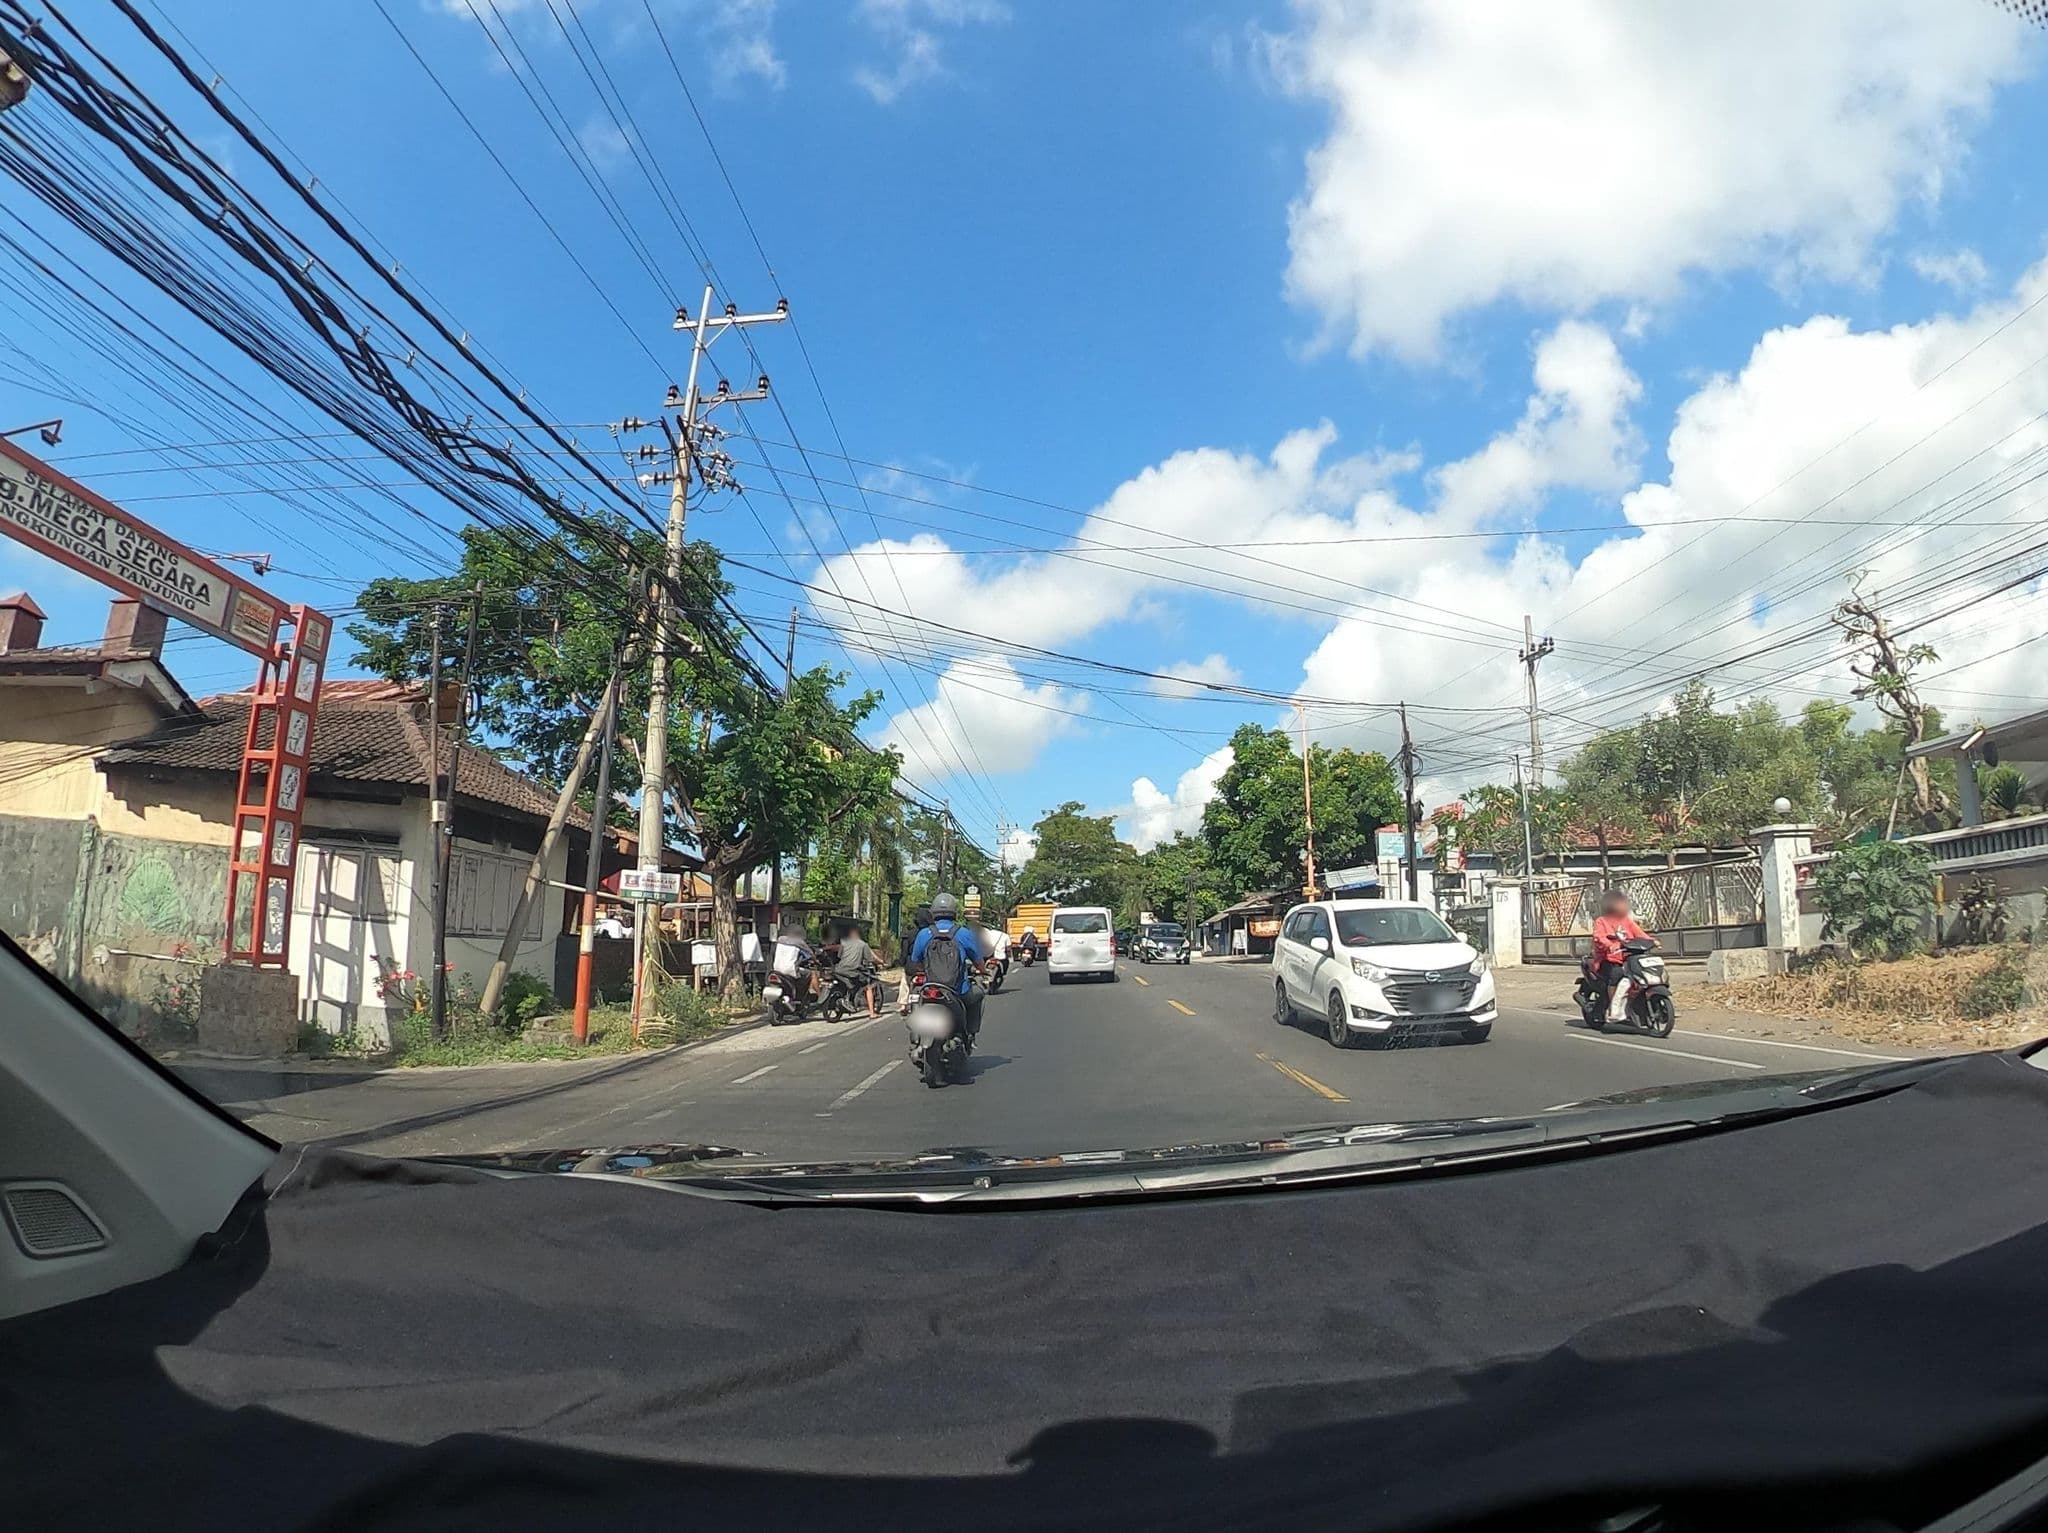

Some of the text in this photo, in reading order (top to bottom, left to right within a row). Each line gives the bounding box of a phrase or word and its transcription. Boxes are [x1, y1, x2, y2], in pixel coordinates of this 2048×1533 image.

[25, 470, 179, 566] SELAMAT DATANG
[29, 489, 107, 550] MEGA
[116, 540, 211, 602] SEGARA
[117, 564, 196, 611] TANJUNG
